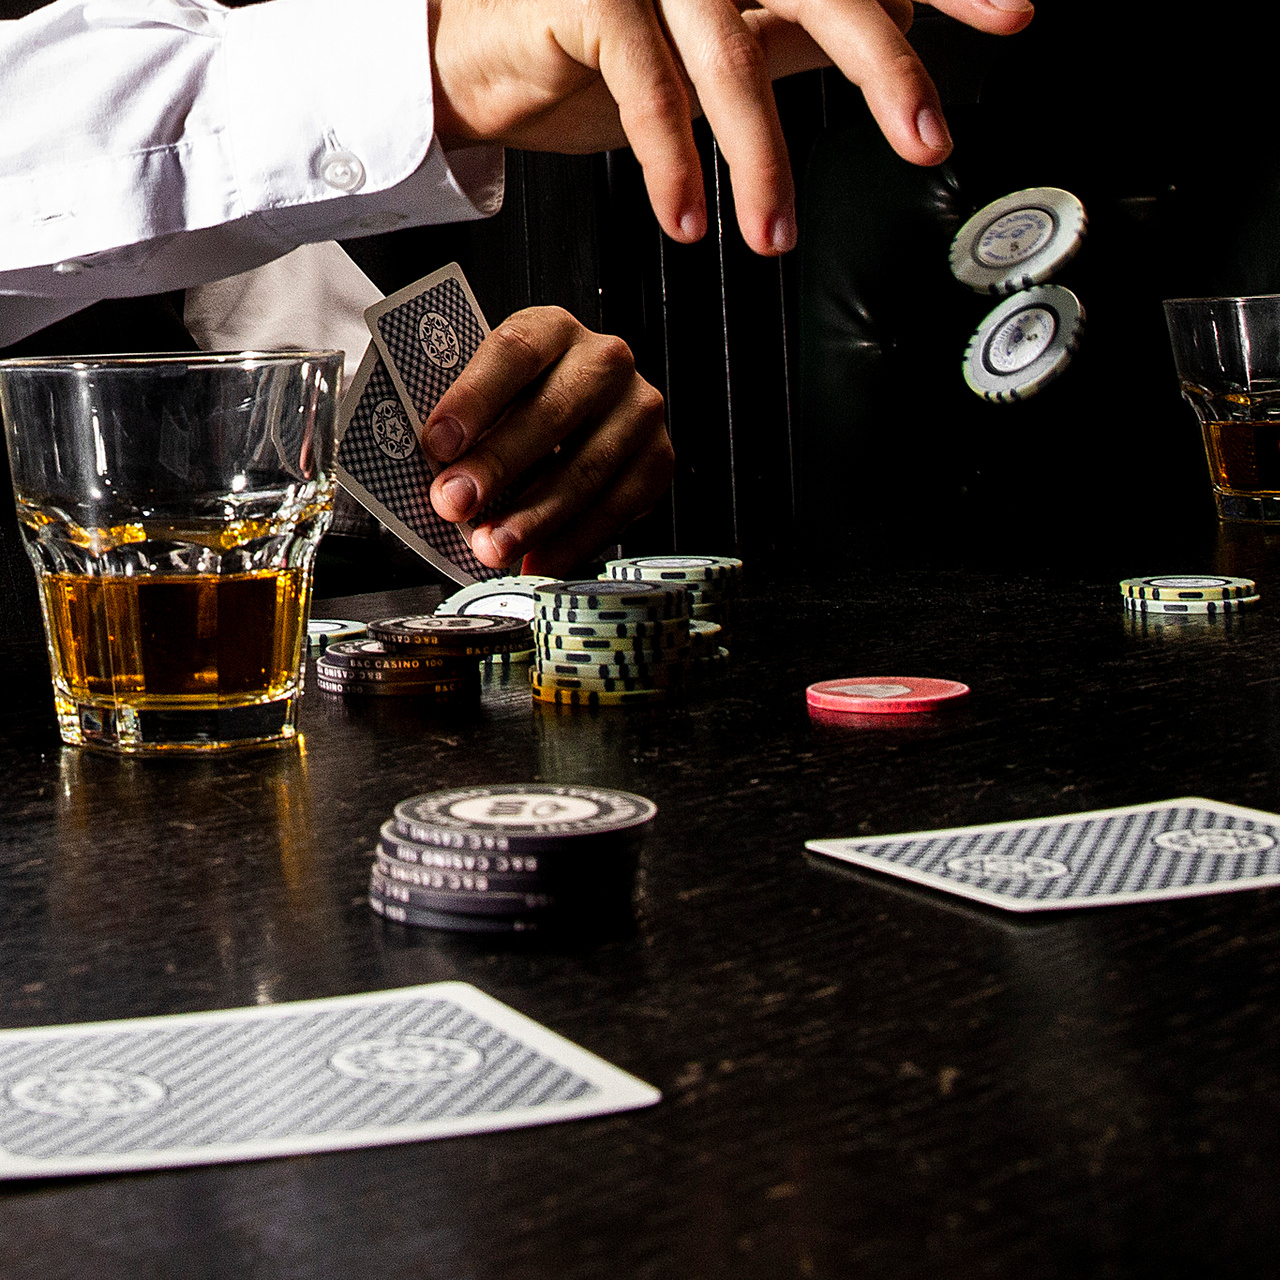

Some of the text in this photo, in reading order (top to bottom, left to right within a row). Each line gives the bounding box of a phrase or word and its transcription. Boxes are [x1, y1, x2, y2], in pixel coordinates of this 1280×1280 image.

[413, 634, 440, 645] B&C
[349, 658, 445, 670] B&C CASINO 100
[360, 671, 383, 681] B&C
